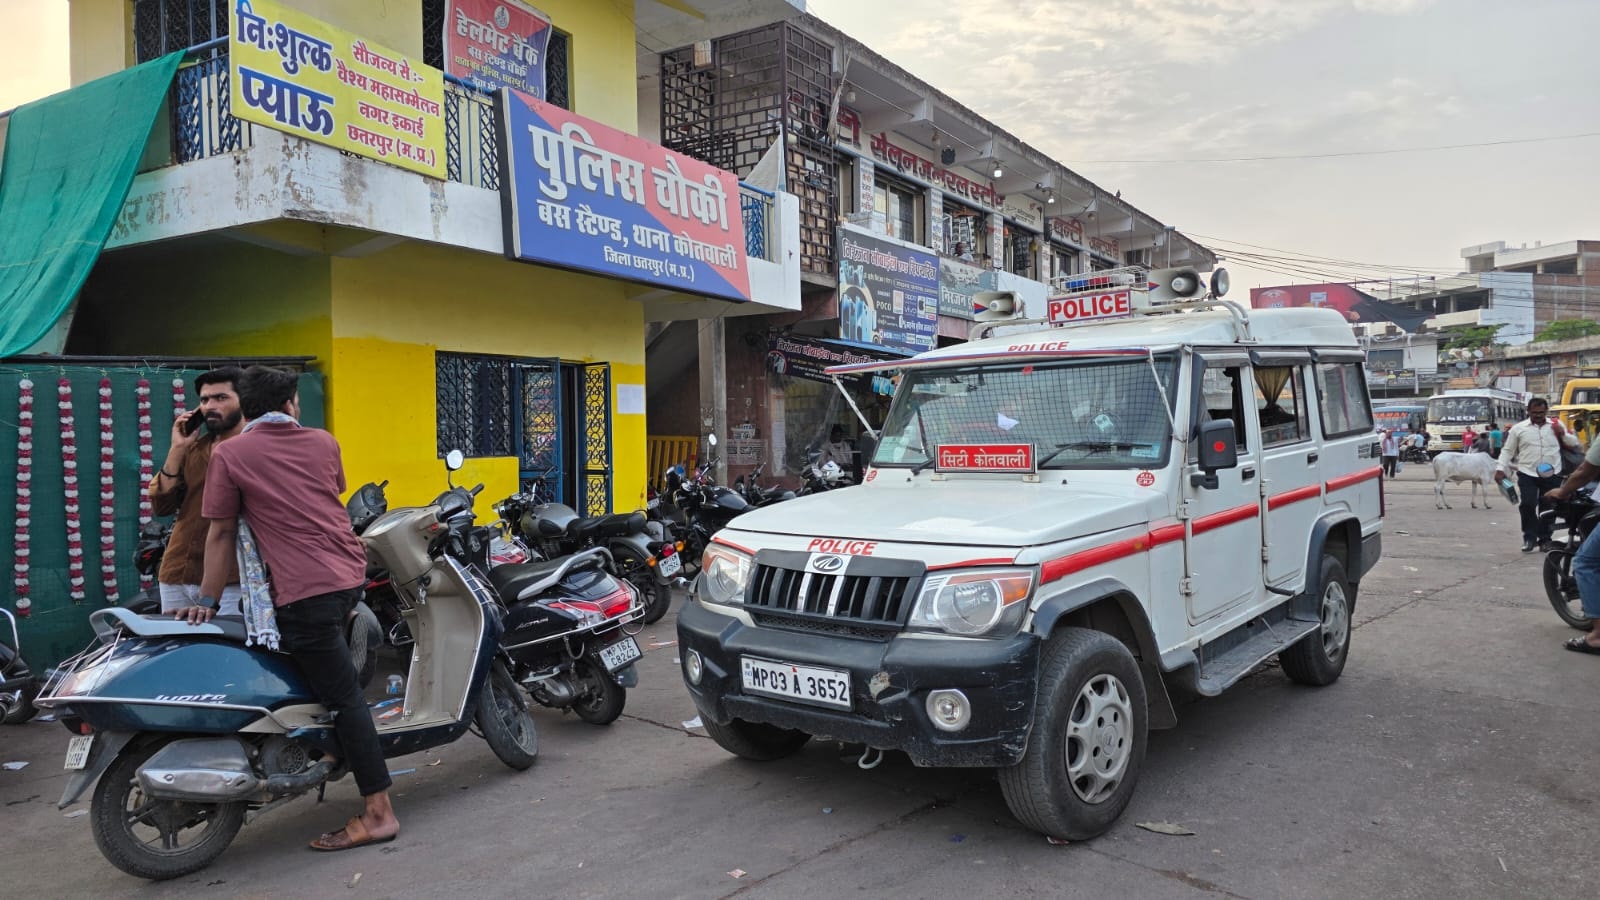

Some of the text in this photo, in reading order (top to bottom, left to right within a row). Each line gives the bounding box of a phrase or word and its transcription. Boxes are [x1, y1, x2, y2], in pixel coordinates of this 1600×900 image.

[352, 40, 398, 76] सौजन्य
[239, 65, 334, 136] प्याऊ
[336, 59, 368, 91] वैश्य
[370, 78, 441, 117] महासम्मेलन
[359, 101, 425, 138] नगर इकाई
[347, 125, 393, 157] छतरपुर
[528, 121, 729, 231] पुलिस चौकी
[536, 199, 571, 230] बस
[632, 223, 671, 253] थाना
[672, 231, 738, 269] कोतवाली
[604, 245, 631, 267] जिला
[1050, 293, 1129, 321] POLICE
[1008, 341, 1070, 352] POLICE
[941, 448, 1026, 467] सिटी कोतवाली
[807, 538, 879, 556] POLICE
[752, 666, 848, 702] MP03 A 3652
